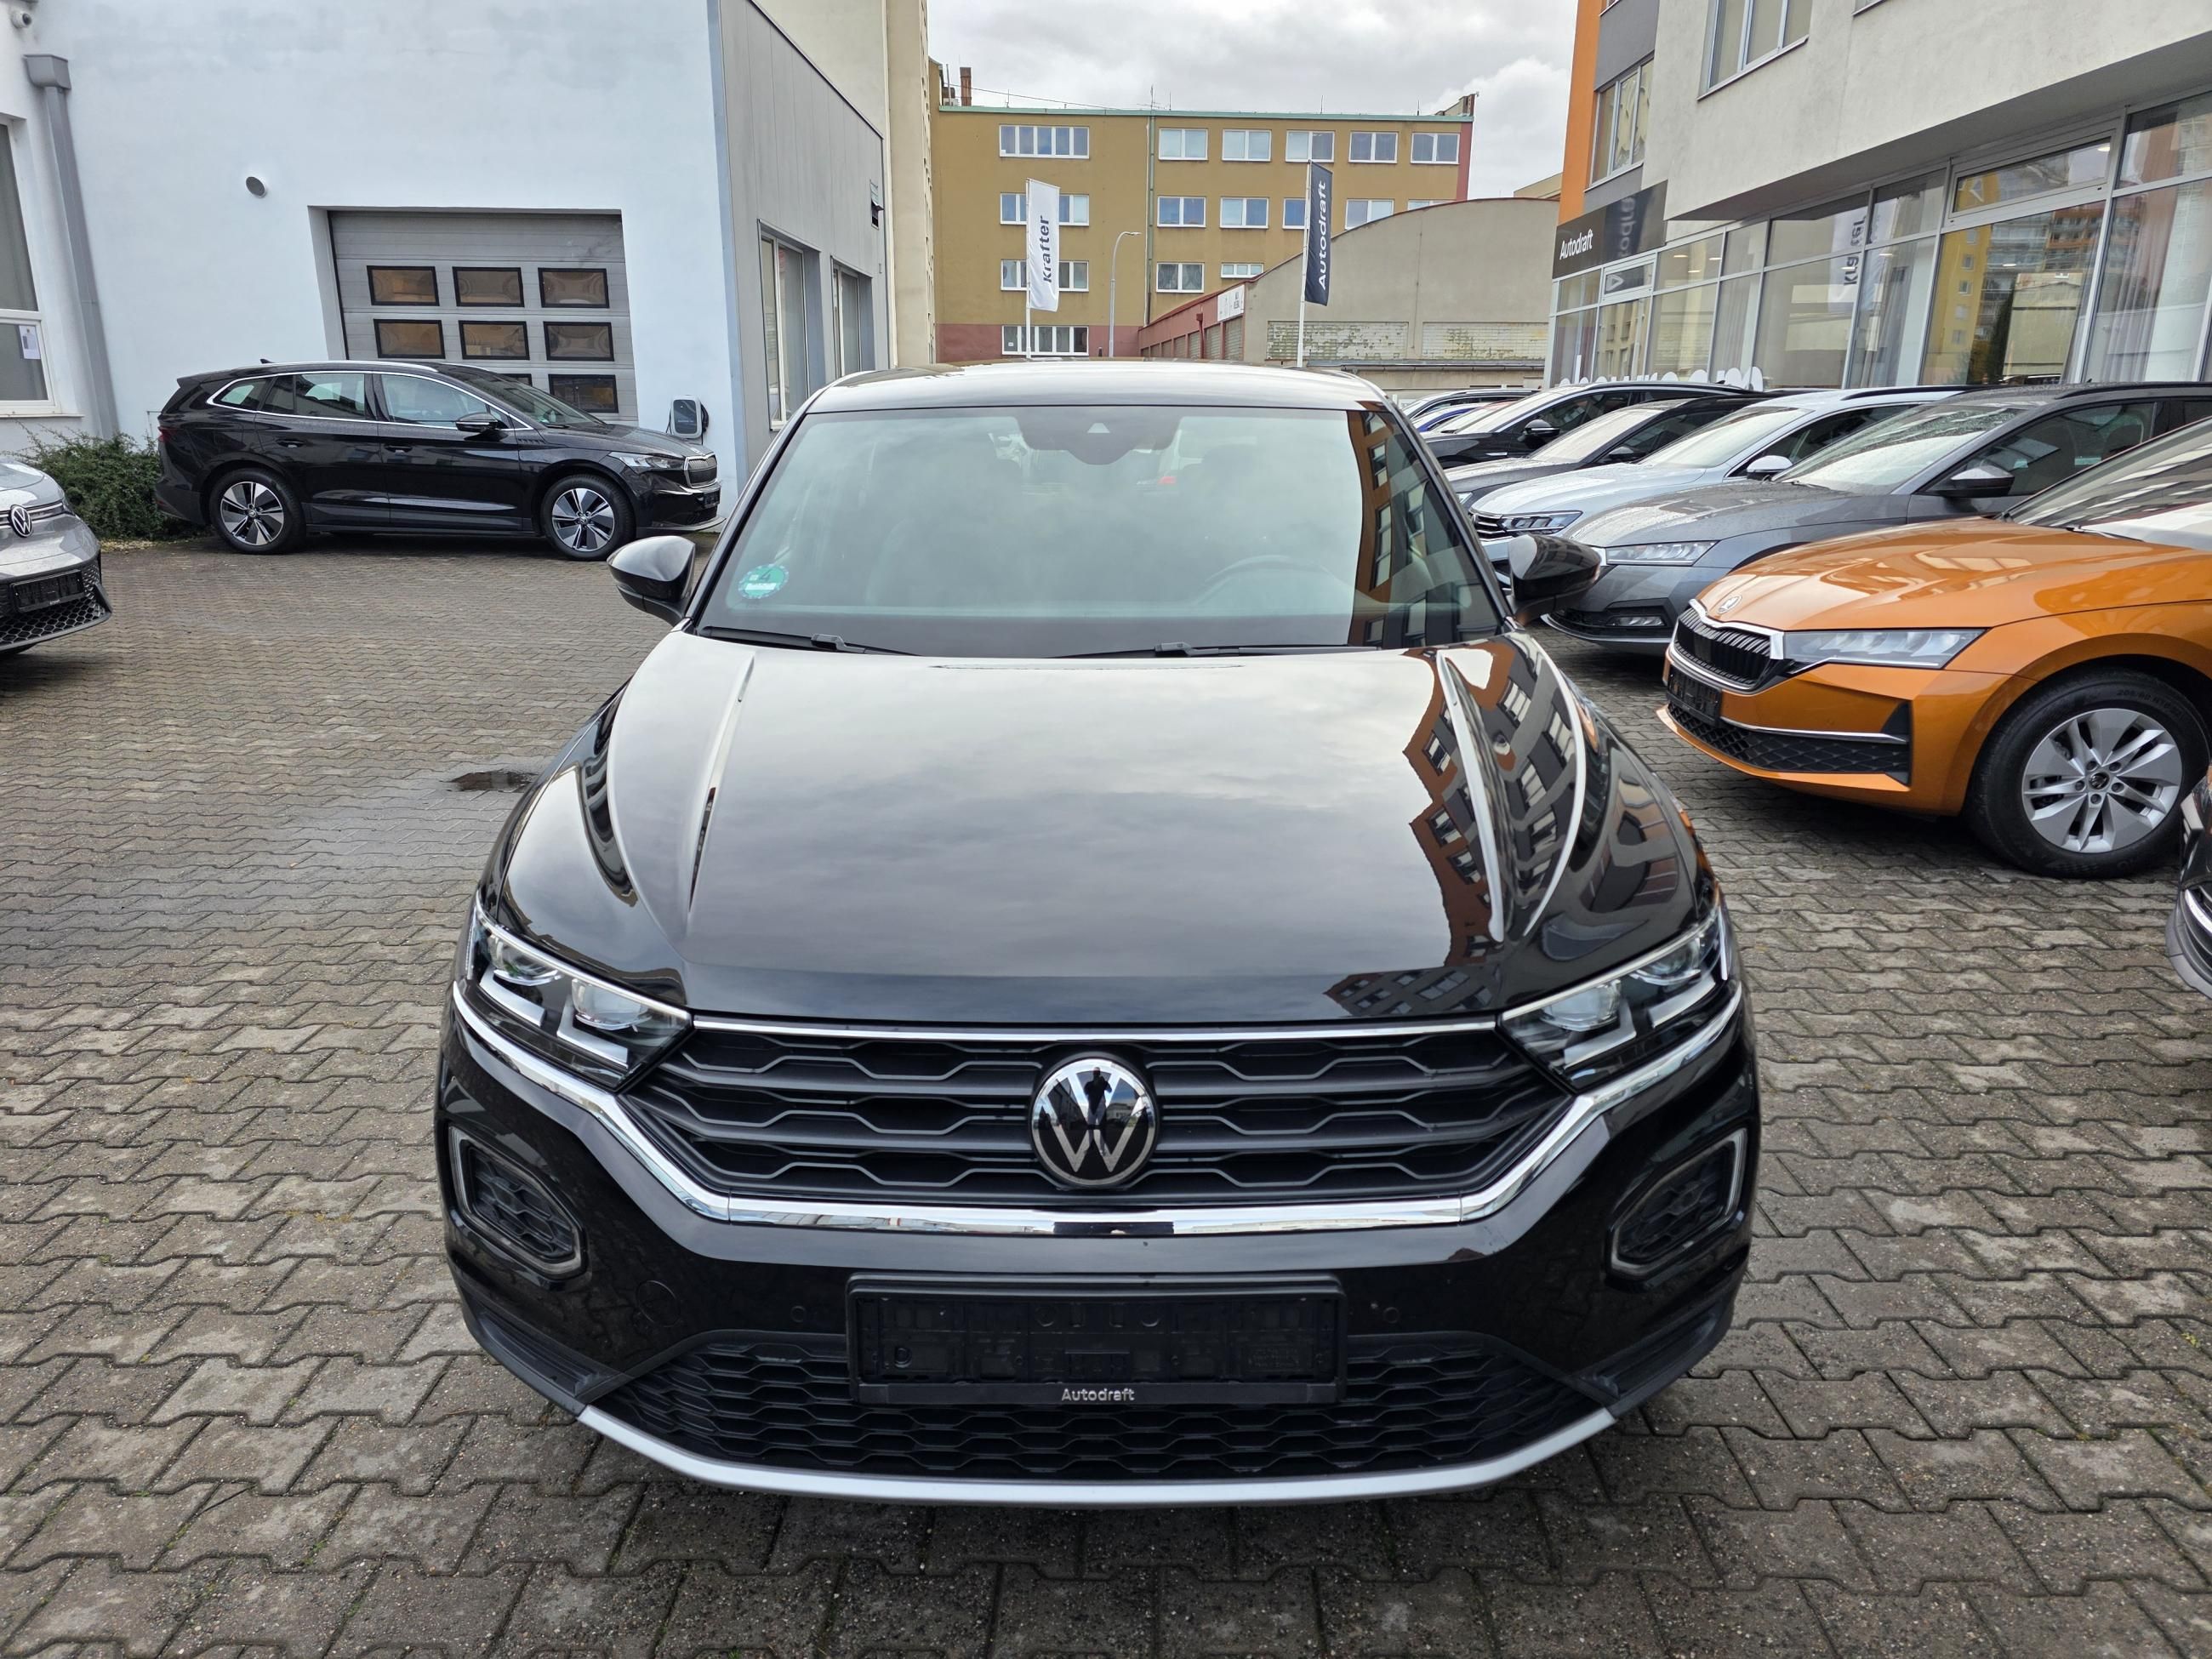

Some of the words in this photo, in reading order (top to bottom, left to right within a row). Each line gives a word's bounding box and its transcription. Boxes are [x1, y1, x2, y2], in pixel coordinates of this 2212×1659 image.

[1039, 214, 1052, 283] Krafter
[1318, 180, 1327, 291] Autodraft
[1559, 228, 1593, 260] Autodraft
[1033, 1059, 1155, 1184] VW
[1061, 1388, 1135, 1401] Autodraft
